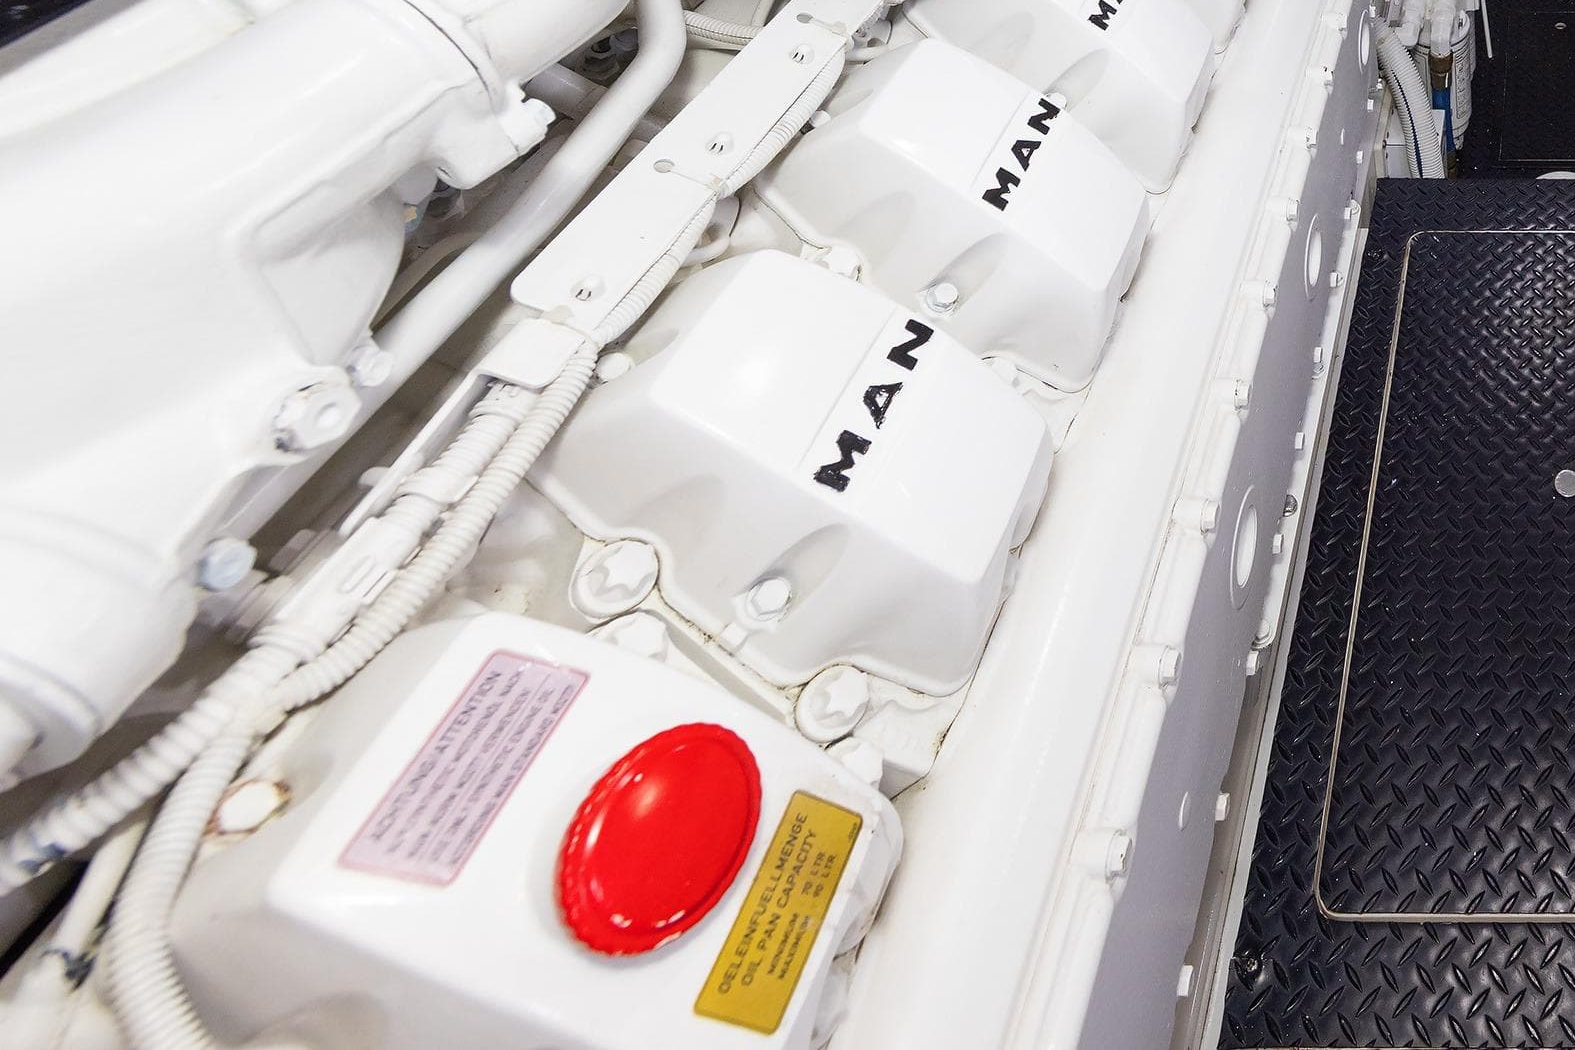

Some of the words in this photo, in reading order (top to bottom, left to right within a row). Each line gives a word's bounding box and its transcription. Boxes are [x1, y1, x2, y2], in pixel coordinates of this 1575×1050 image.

[981, 97, 1061, 212] MAN
[813, 318, 935, 492] MAN
[715, 810, 808, 995] OELEINFUELLMENGE
[739, 955, 762, 988] OIL
[756, 911, 782, 951] PAN
[774, 828, 818, 910] CAPACITY
[765, 912, 800, 976] MINIMUM
[777, 914, 811, 980] MAXIMUM
